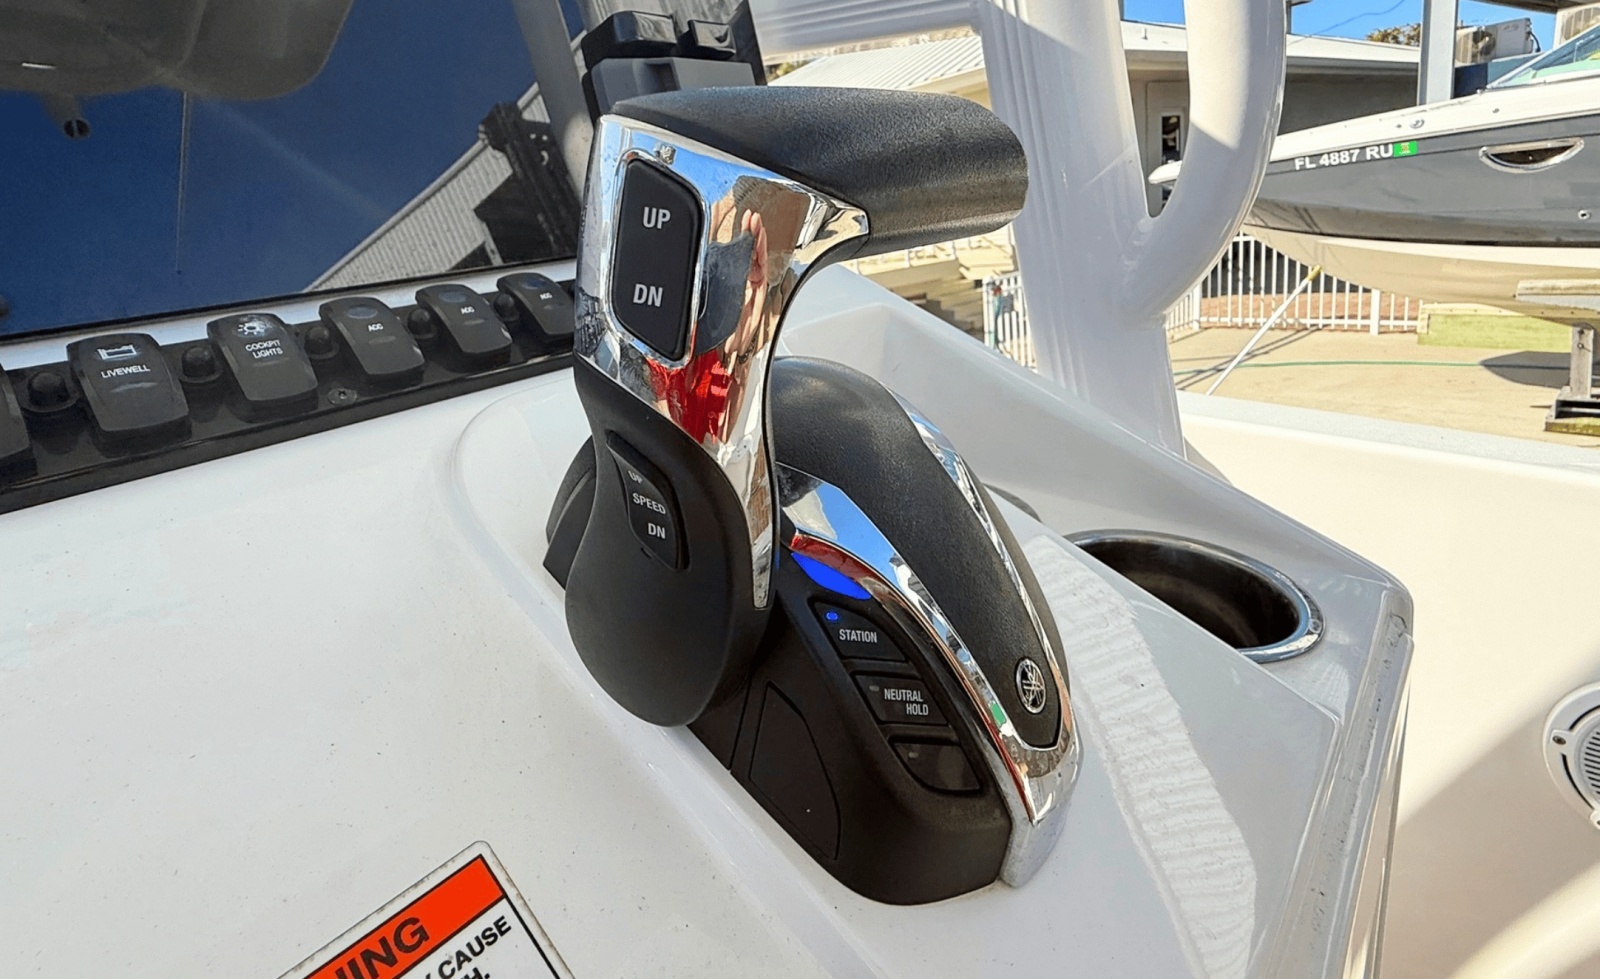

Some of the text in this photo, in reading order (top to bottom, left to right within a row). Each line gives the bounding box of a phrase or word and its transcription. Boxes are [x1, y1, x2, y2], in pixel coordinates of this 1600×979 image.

[1294, 157, 1316, 171] FL
[1319, 149, 1360, 167] 4887
[1365, 143, 1393, 160] RU
[642, 206, 671, 229] UP
[632, 283, 663, 307] DN
[245, 339, 281, 352] COCKPIT
[252, 347, 284, 359] LIGHTS
[101, 364, 151, 379] LIVEWELL
[628, 470, 643, 484] UP
[632, 493, 666, 515] SPEED
[647, 522, 666, 539] DN
[839, 629, 878, 643] STATION
[884, 688, 923, 702] NEUTRAL
[906, 703, 929, 716] HOLD
[437, 915, 512, 979] CAUSE
